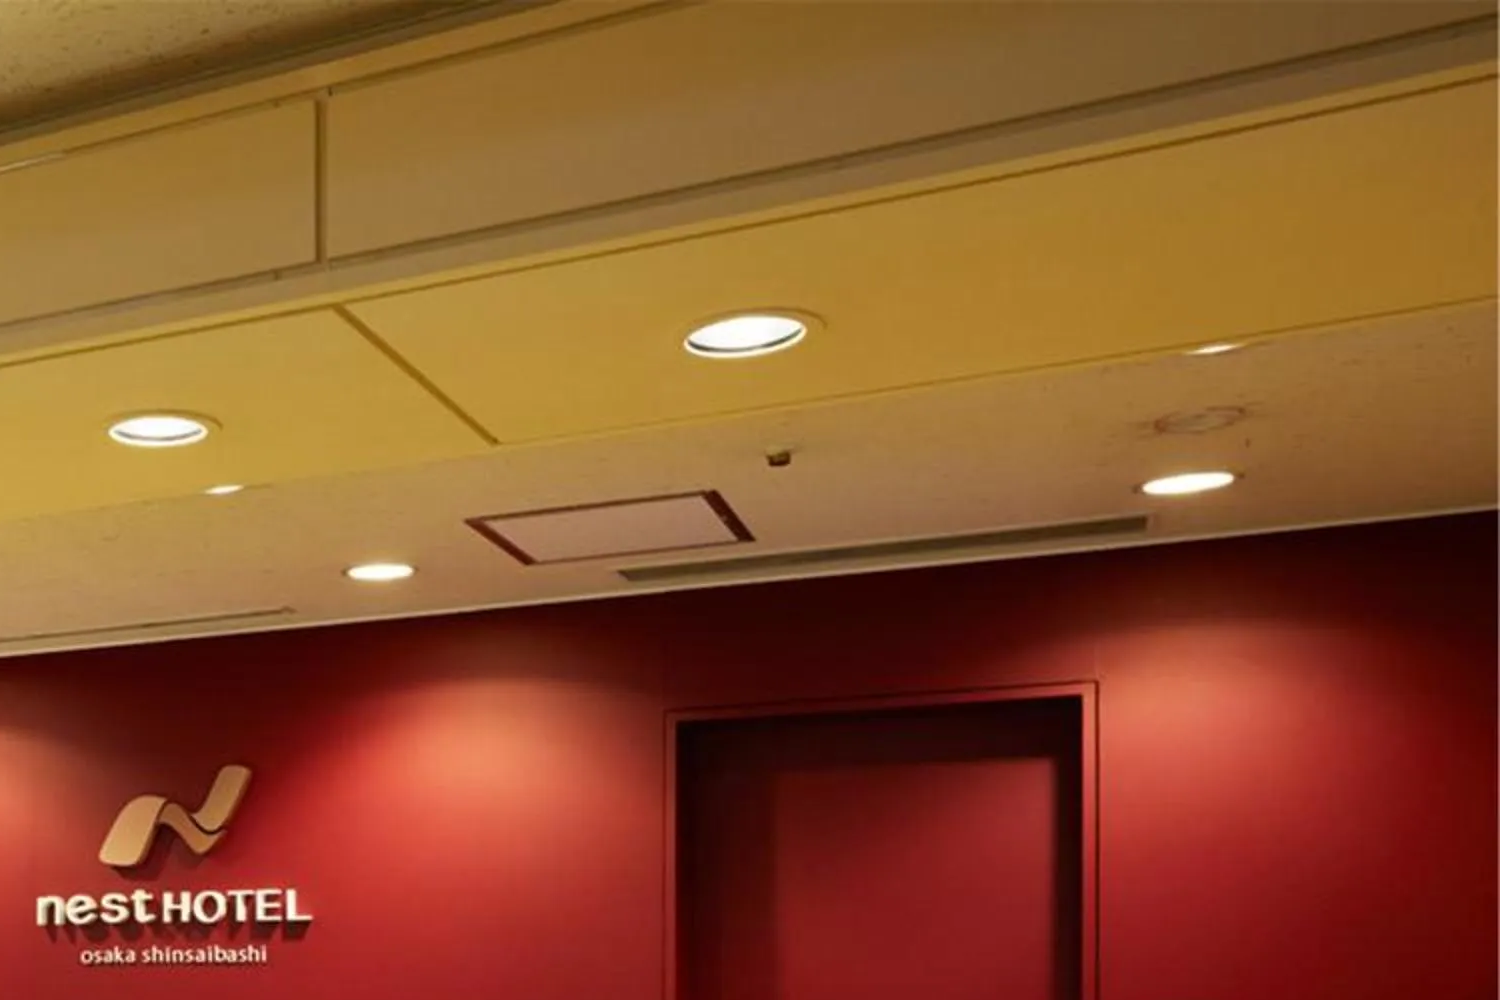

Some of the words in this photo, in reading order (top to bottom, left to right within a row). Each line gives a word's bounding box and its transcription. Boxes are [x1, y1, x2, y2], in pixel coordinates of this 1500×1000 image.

[35, 889, 156, 926] nest
[162, 887, 313, 923] HOTEL
[79, 946, 136, 965] osaka
[140, 943, 268, 963] shinsaibashi
